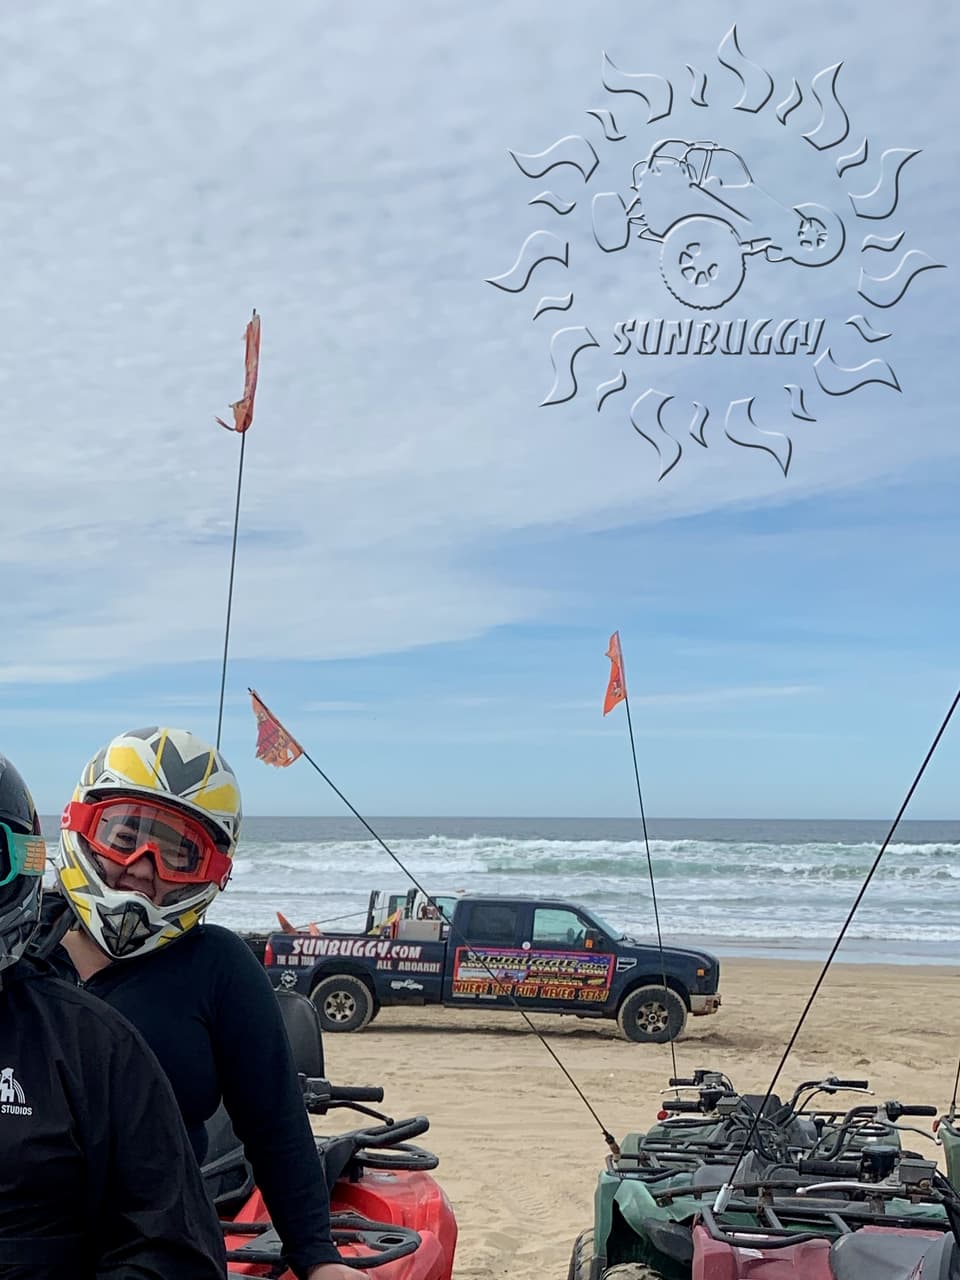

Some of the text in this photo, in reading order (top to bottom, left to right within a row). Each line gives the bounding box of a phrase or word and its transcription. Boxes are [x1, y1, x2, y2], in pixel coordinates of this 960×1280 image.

[291, 938, 422, 959] SUNBUGGY.COM
[376, 959, 440, 973] ALL ABOARD!
[577, 967, 608, 976] NOW!
[453, 982, 489, 993] WHERE
[514, 984, 539, 998] FUN
[540, 986, 577, 999] NEVER
[1, 1105, 32, 1115] STUDIOS
